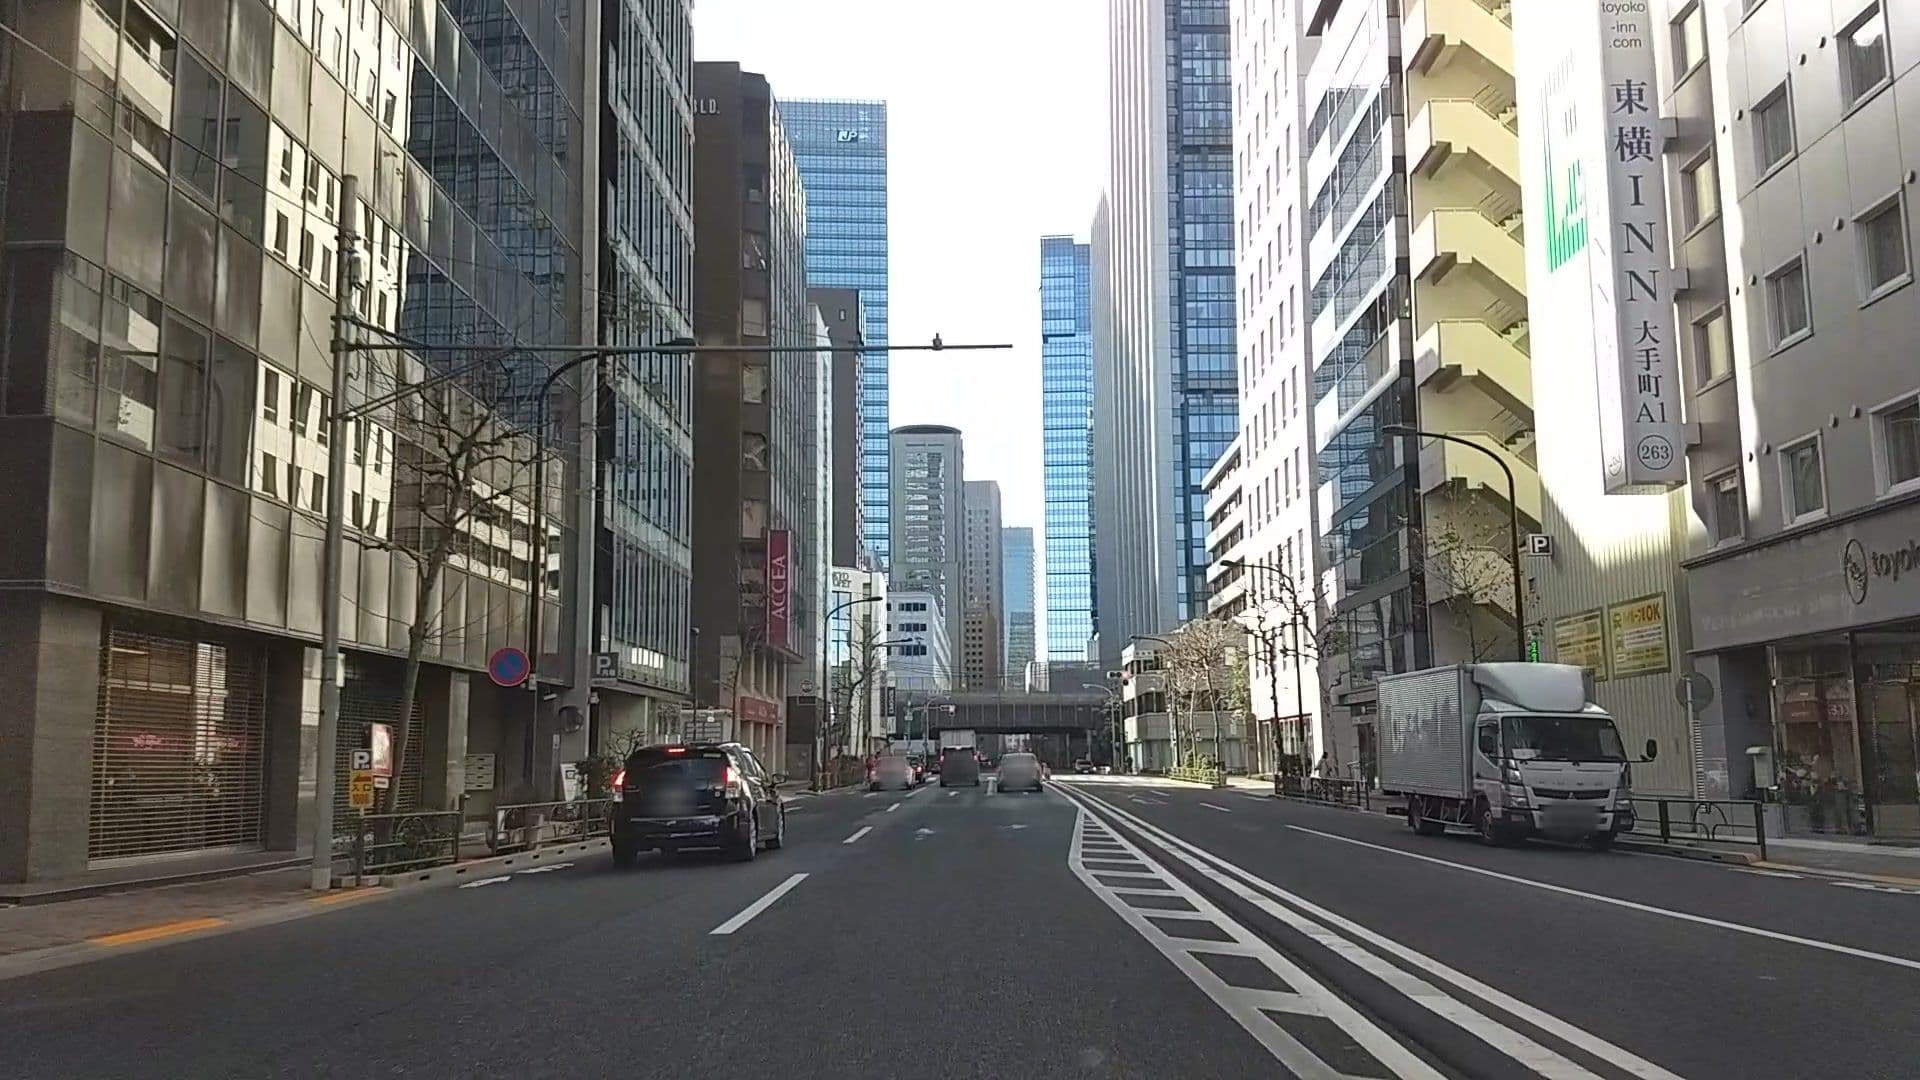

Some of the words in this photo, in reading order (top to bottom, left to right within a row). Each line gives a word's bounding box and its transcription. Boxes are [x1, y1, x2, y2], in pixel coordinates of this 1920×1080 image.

[1602, 0, 1646, 15] toyoko
[1611, 20, 1637, 33] -inn
[1609, 38, 1642, 48] .com
[1610, 79, 1660, 303] 東横INN
[1641, 445, 1670, 460] 263
[1533, 537, 1548, 552] P
[771, 555, 786, 620] ACCEA
[596, 656, 611, 675] P
[353, 751, 370, 769] P
